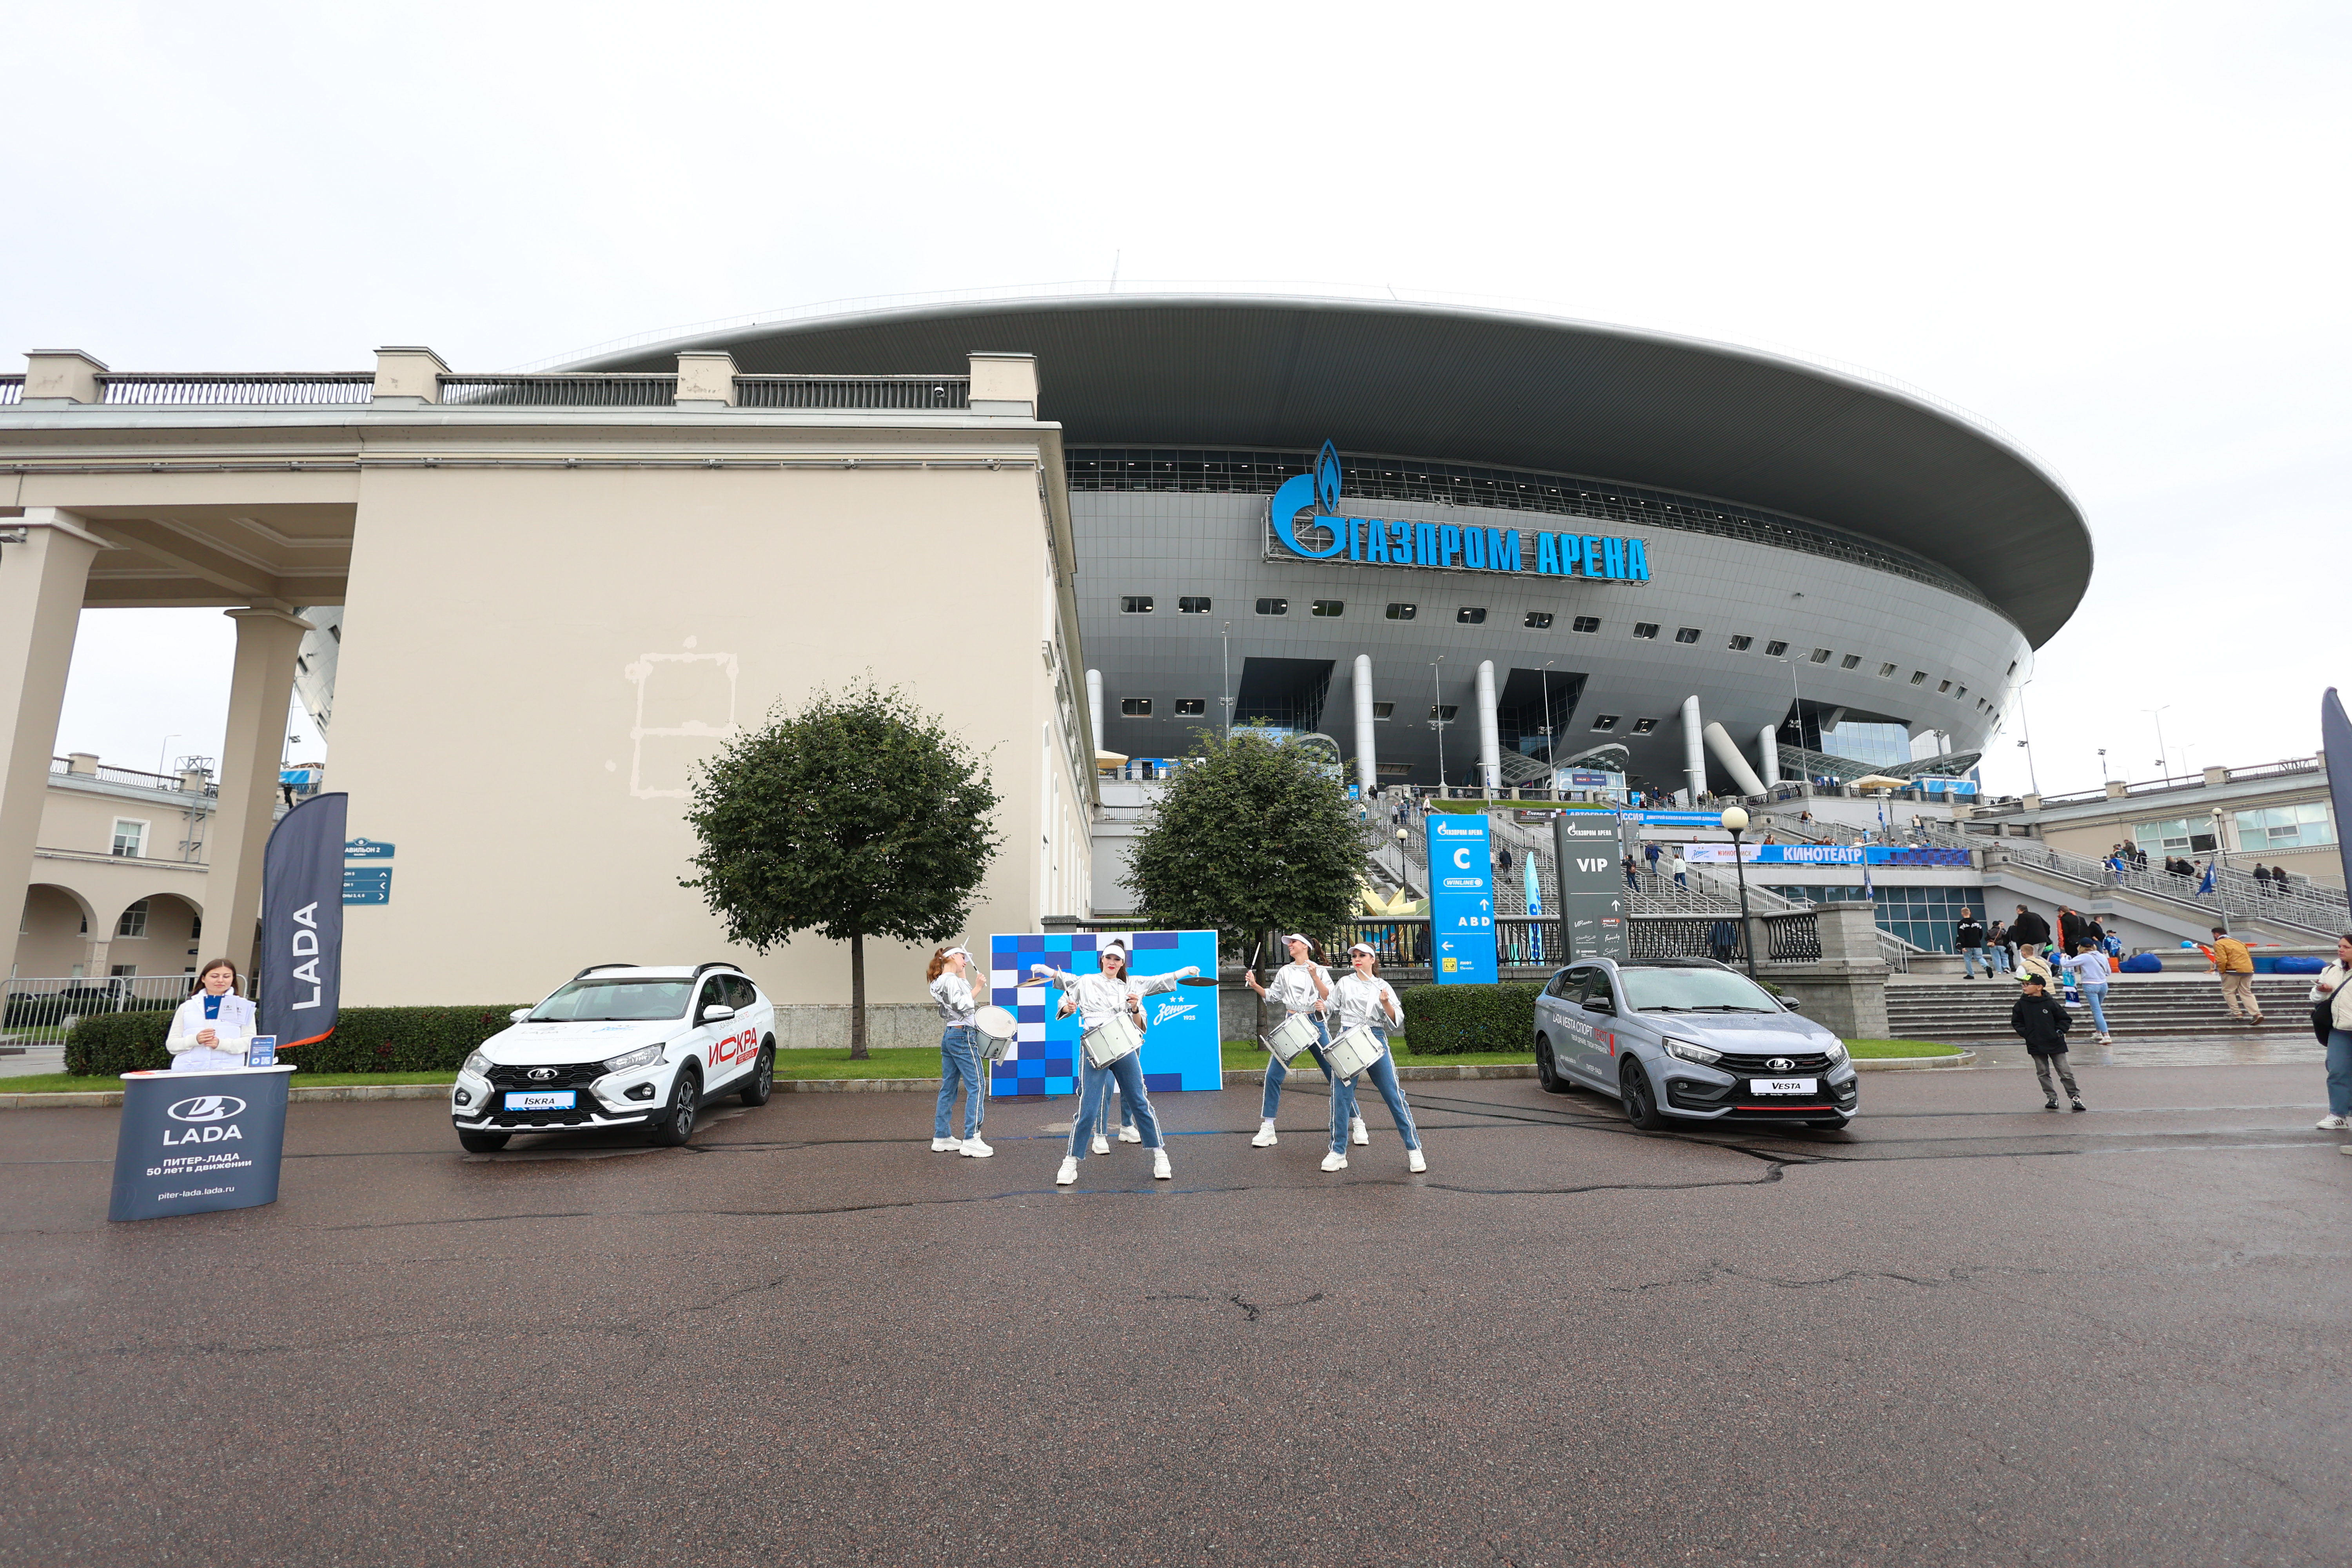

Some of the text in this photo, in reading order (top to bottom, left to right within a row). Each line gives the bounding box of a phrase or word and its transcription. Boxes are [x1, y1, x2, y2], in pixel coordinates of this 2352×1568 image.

[1348, 517, 1649, 581] ГАЗПРОМ АРЕНА
[1783, 847, 1862, 862] КИНОТЕАТР
[1576, 858, 1608, 872] VIP
[1458, 916, 1490, 926] A B D
[1605, 933, 1620, 942] Family
[292, 901, 321, 1010] LADA
[1553, 1013, 1608, 1042] LADA VESTA СПОРТ ТЕСТ
[708, 1027, 757, 1068] ИСКРА
[1594, 1044, 1608, 1054] ПРАВИЛА
[1586, 1063, 1602, 1075] ПИТЕР-ЛАДА
[163, 1124, 243, 1146] LADA
[163, 1153, 240, 1167] ПИТЕР-ЛАДА
[146, 1167, 162, 1176] 50
[194, 1160, 252, 1172] движении
[158, 1186, 235, 1201] piter-lada.lada.ru
